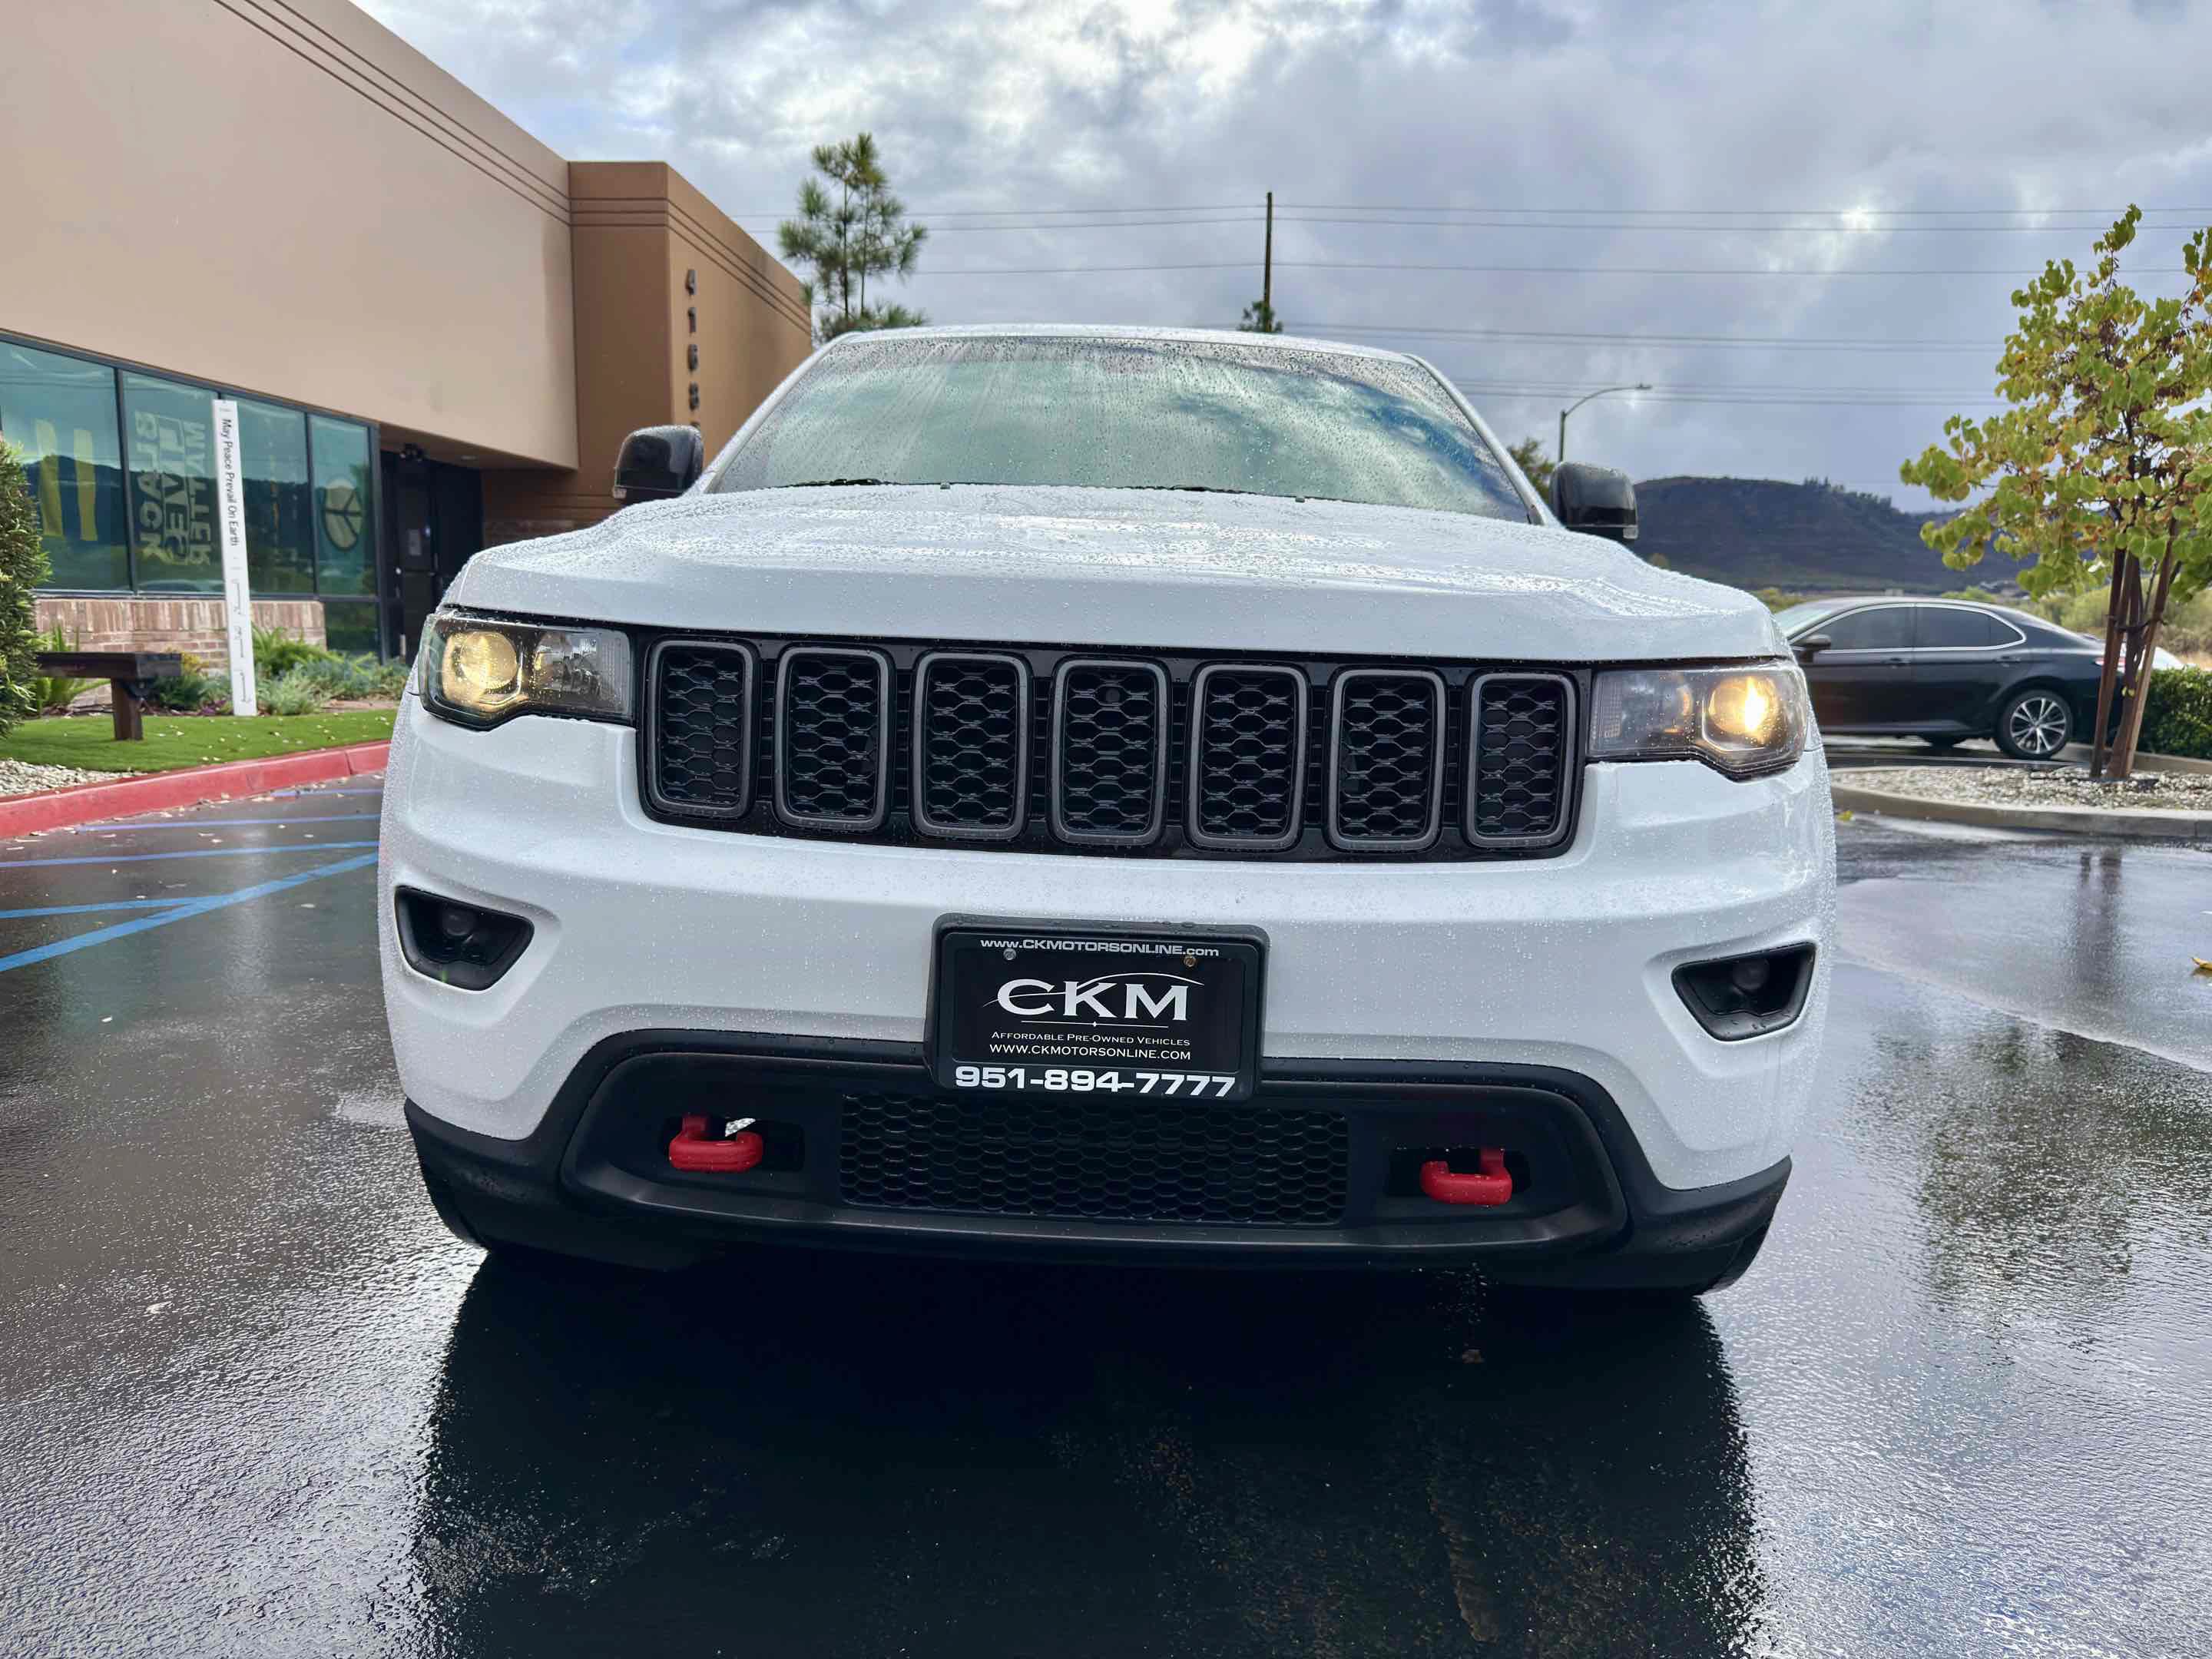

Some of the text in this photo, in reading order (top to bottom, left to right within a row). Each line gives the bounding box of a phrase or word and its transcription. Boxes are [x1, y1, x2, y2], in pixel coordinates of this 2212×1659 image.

[220, 419, 240, 546] May Peace Prevail On Earth
[980, 939, 1220, 957] www.CKMOTORSONLINE.com
[997, 979, 1189, 1021] CKM
[989, 1044, 1190, 1061] WWW.CKMOTORSONLINE.COM
[955, 1065, 1236, 1098] 951-894-7777
